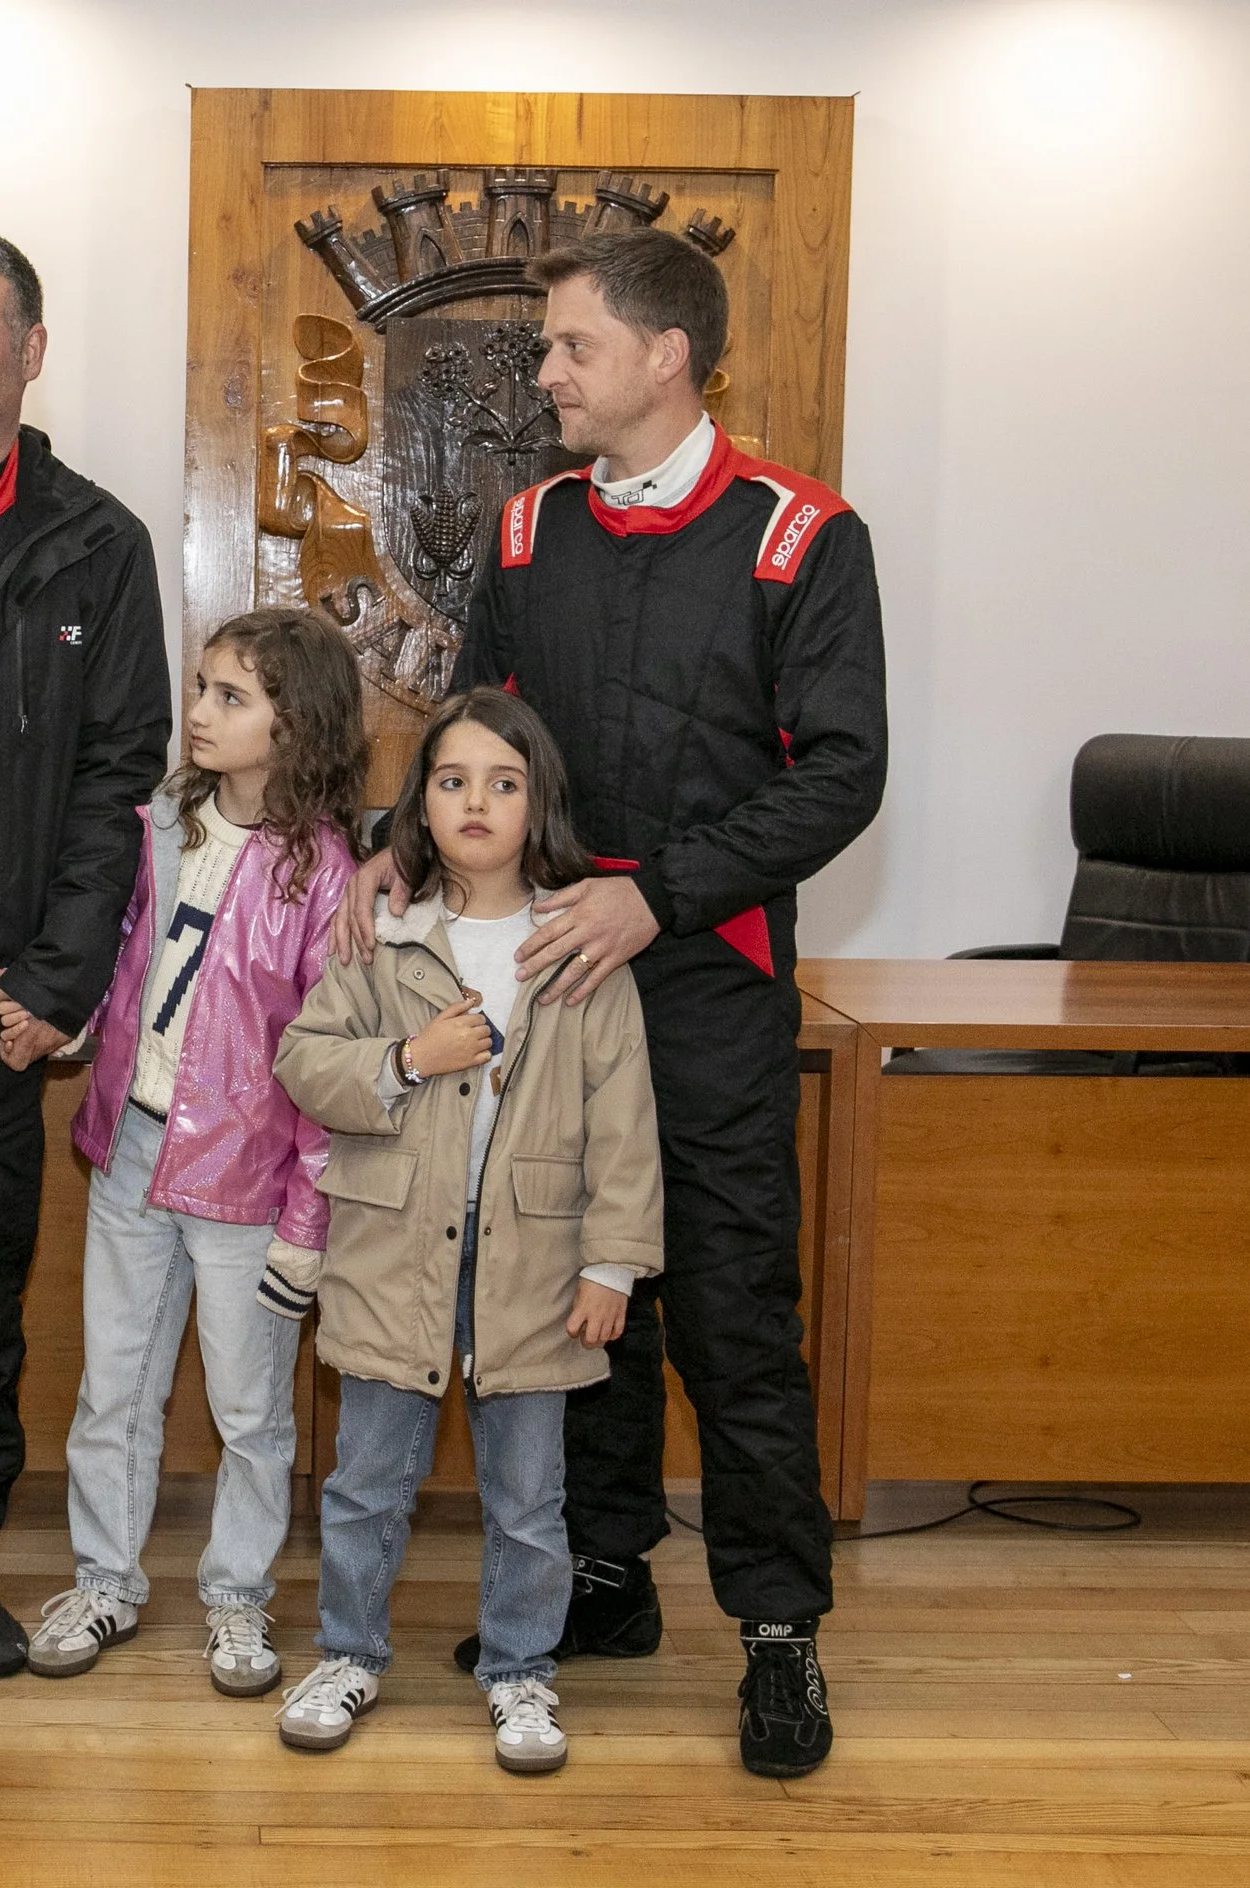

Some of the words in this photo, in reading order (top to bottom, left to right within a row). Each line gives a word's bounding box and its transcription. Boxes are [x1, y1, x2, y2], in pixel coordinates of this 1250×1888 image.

[511, 497, 525, 556] sparco
[772, 504, 819, 570] sparco
[152, 901, 215, 1036] 7
[759, 1624, 793, 1637] OMP
